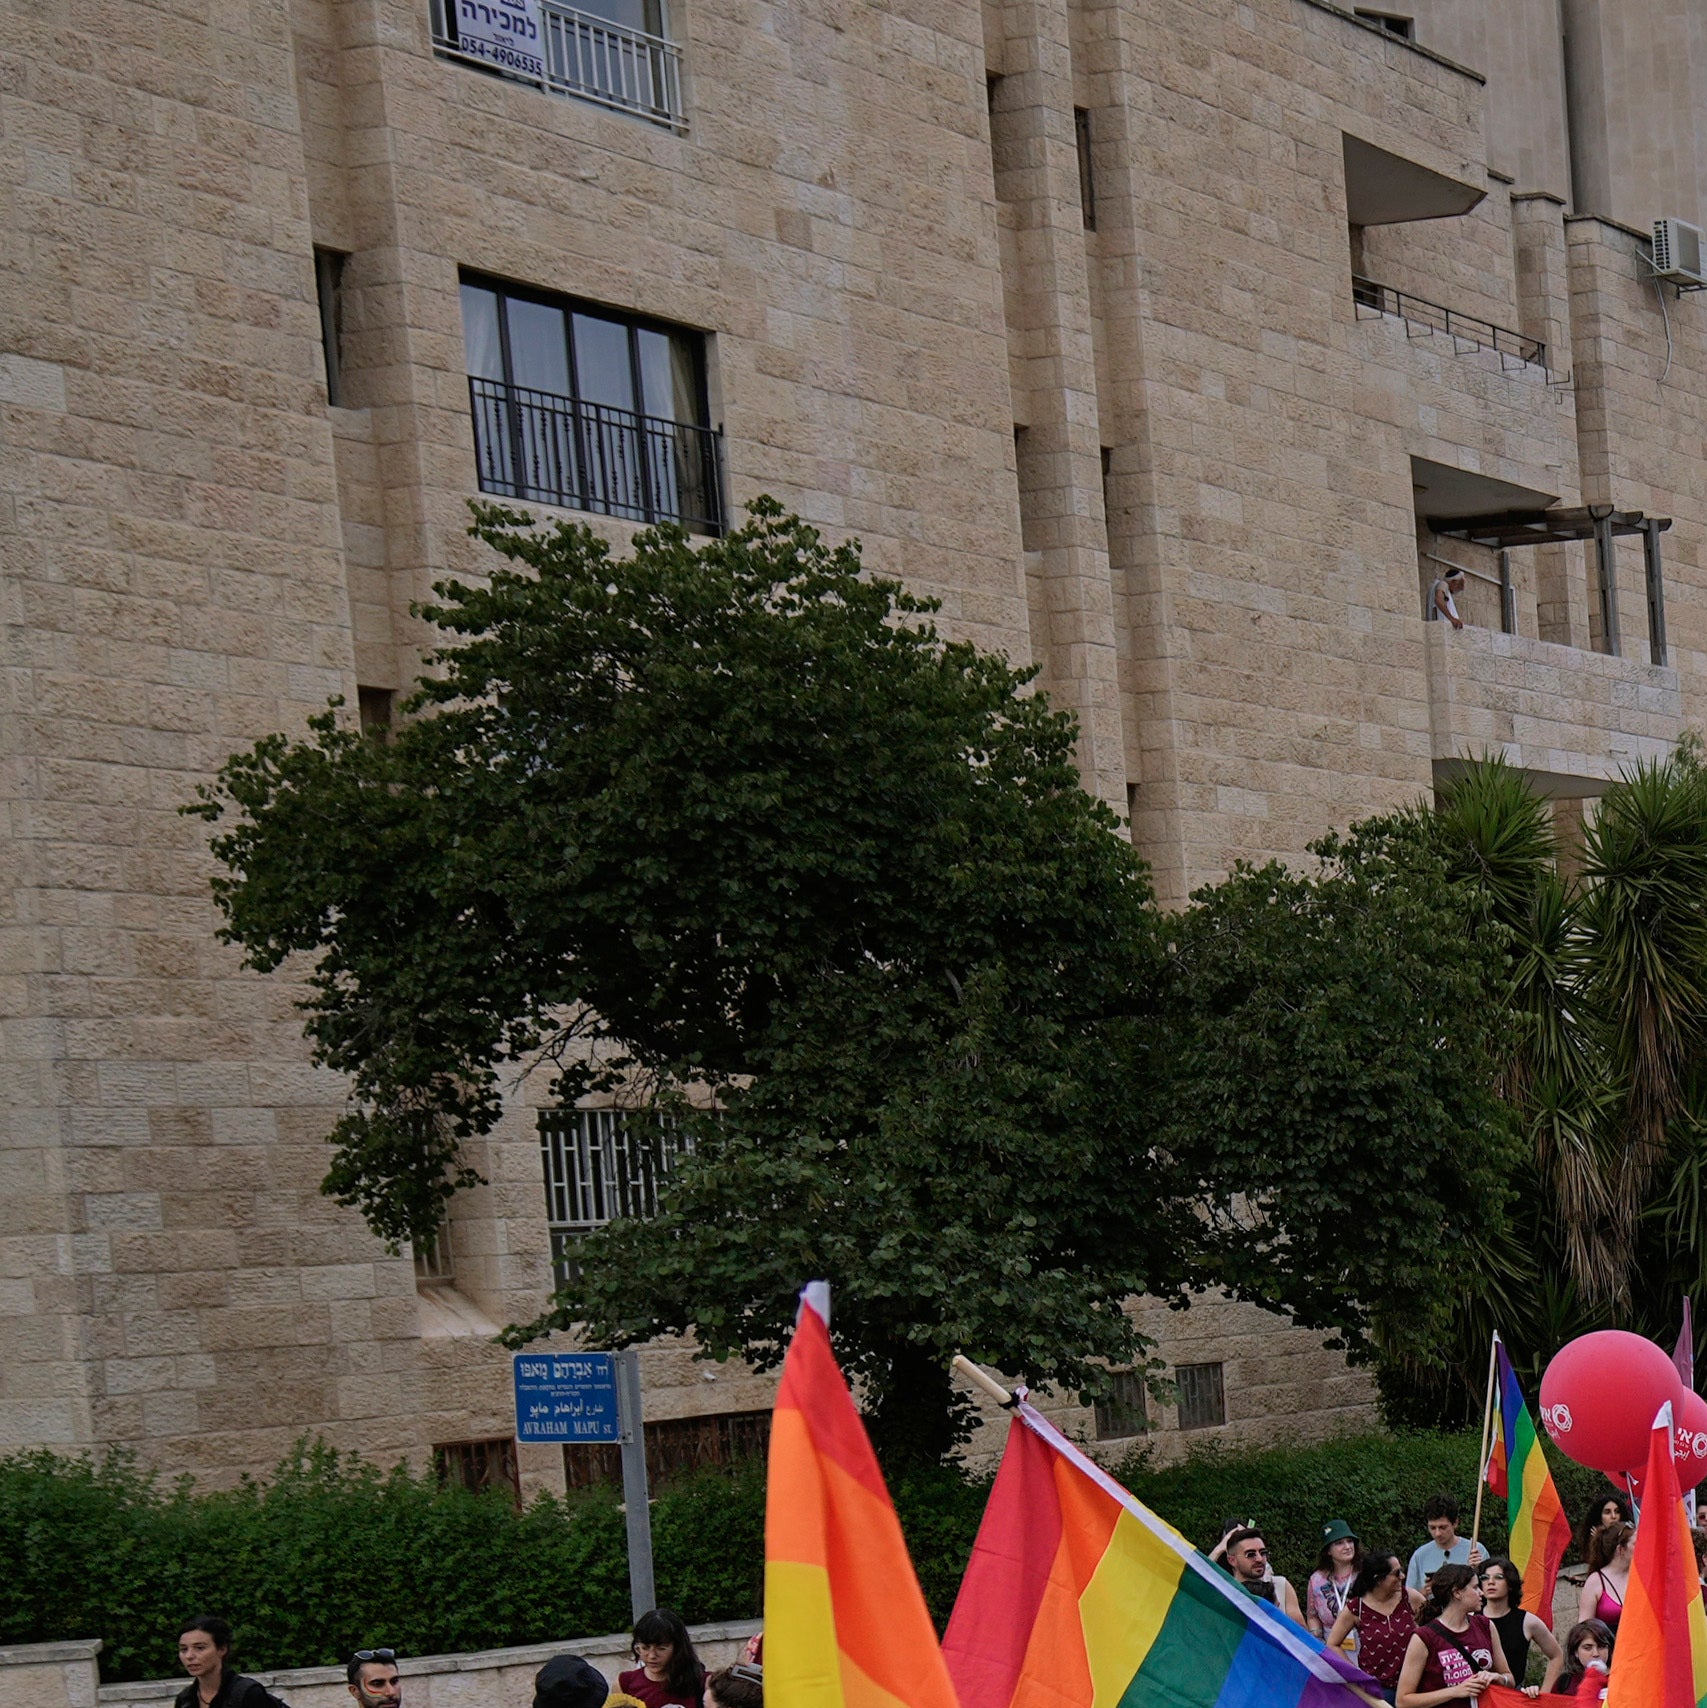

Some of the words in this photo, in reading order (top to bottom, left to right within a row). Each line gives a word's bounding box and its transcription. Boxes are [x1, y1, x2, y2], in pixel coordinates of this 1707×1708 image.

[462, 0, 537, 39] למכירה
[461, 37, 543, 77] 054-4906535
[523, 1421, 568, 1434] AVRAHAM
[573, 1421, 600, 1434] MAPU
